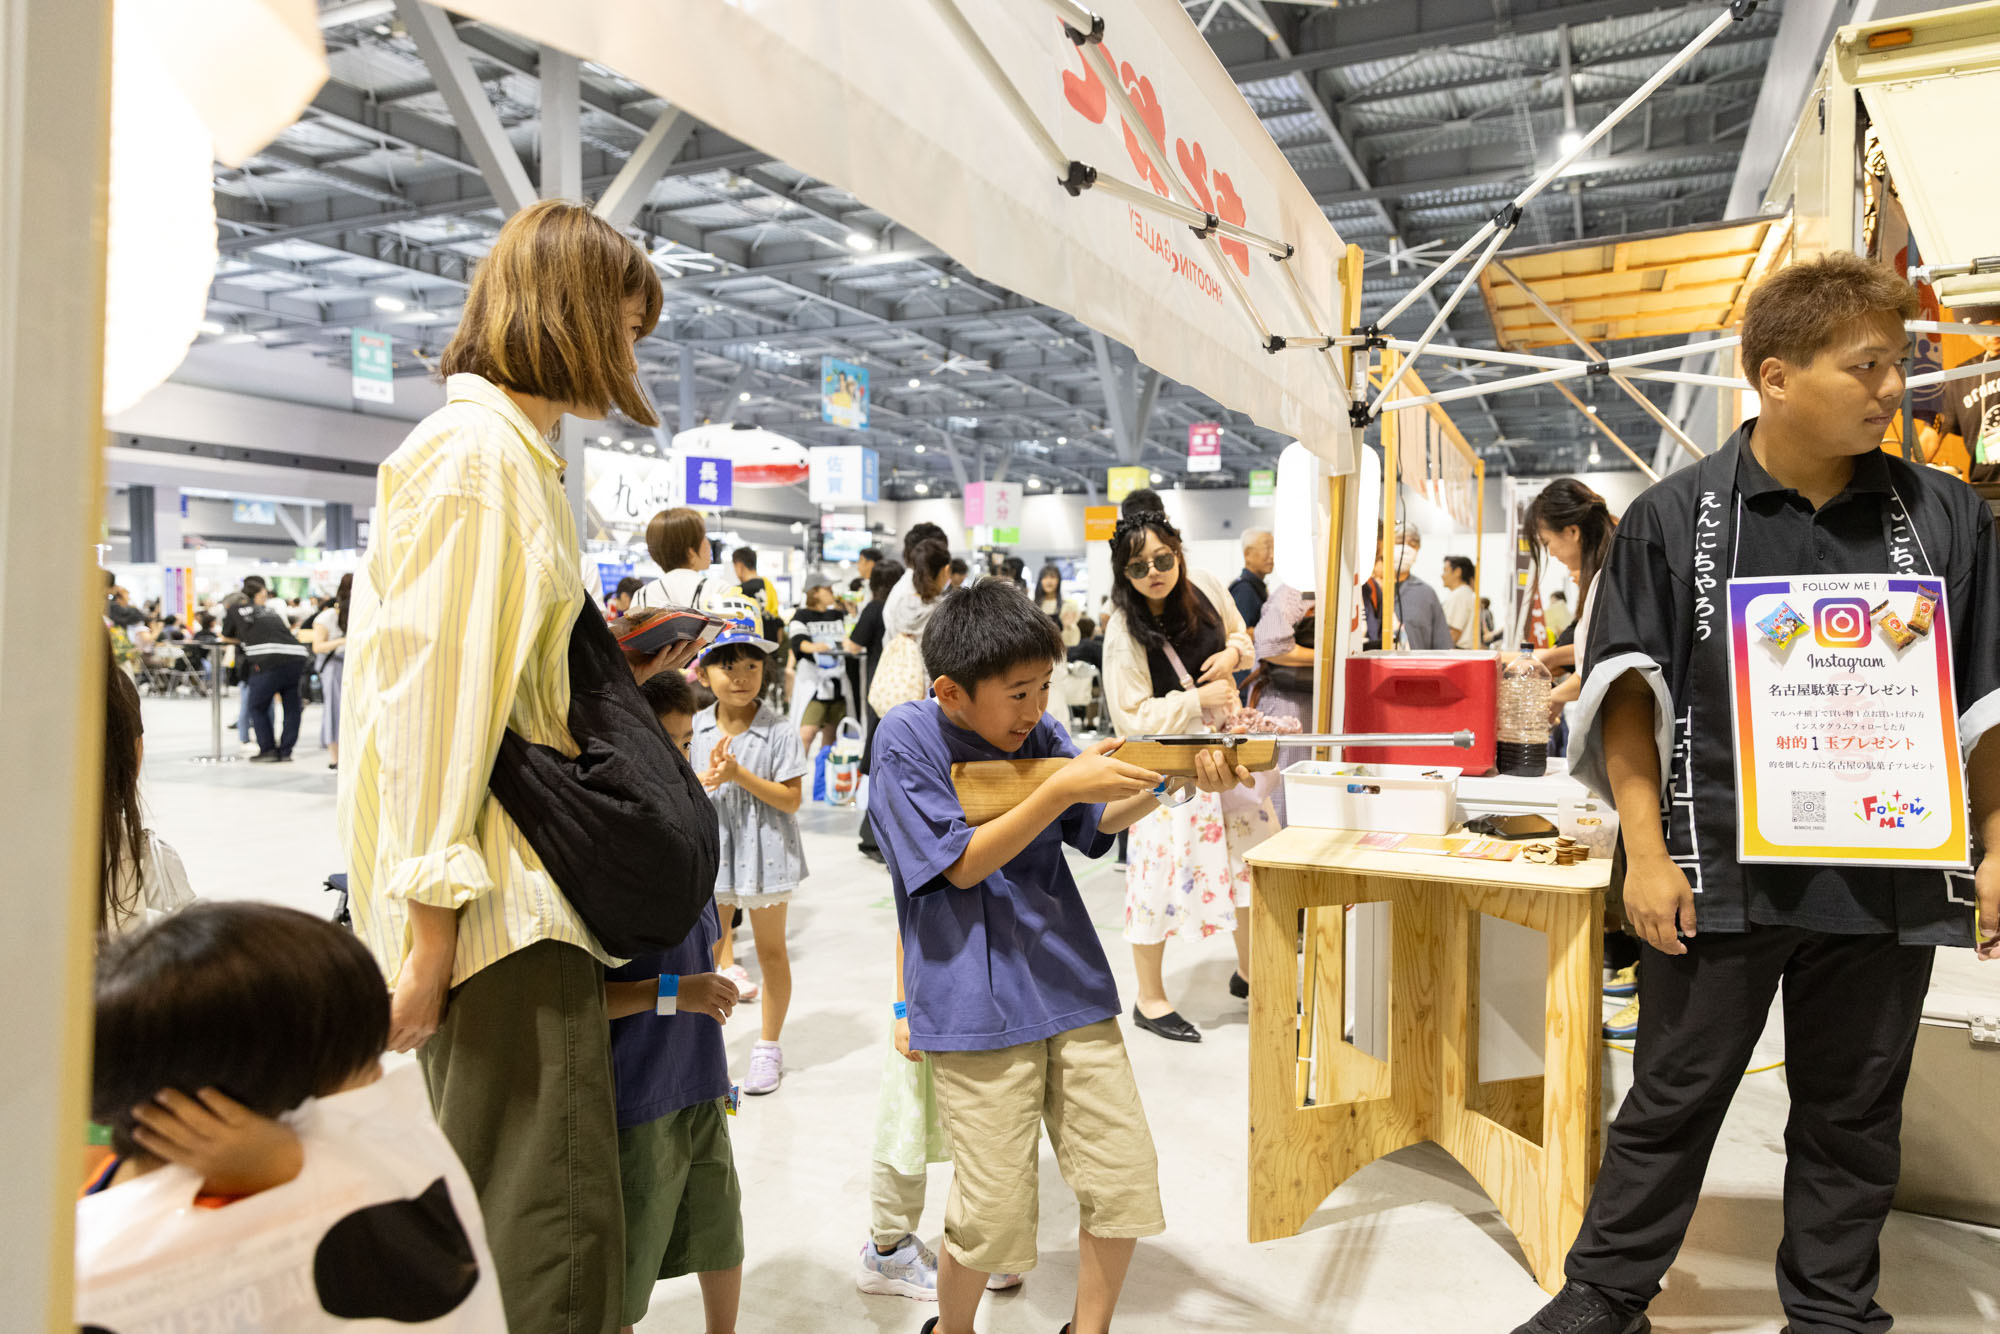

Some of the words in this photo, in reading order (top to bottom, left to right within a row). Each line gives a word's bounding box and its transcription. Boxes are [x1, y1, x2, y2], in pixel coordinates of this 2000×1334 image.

[1694, 491, 1722, 641] えんにちやろう
[1802, 581, 1850, 592] FOLLOW
[1854, 581, 1870, 590] ME
[1806, 653, 1886, 674] Instagram
[1768, 683, 1920, 697] 名古屋駄菓子プレゼント
